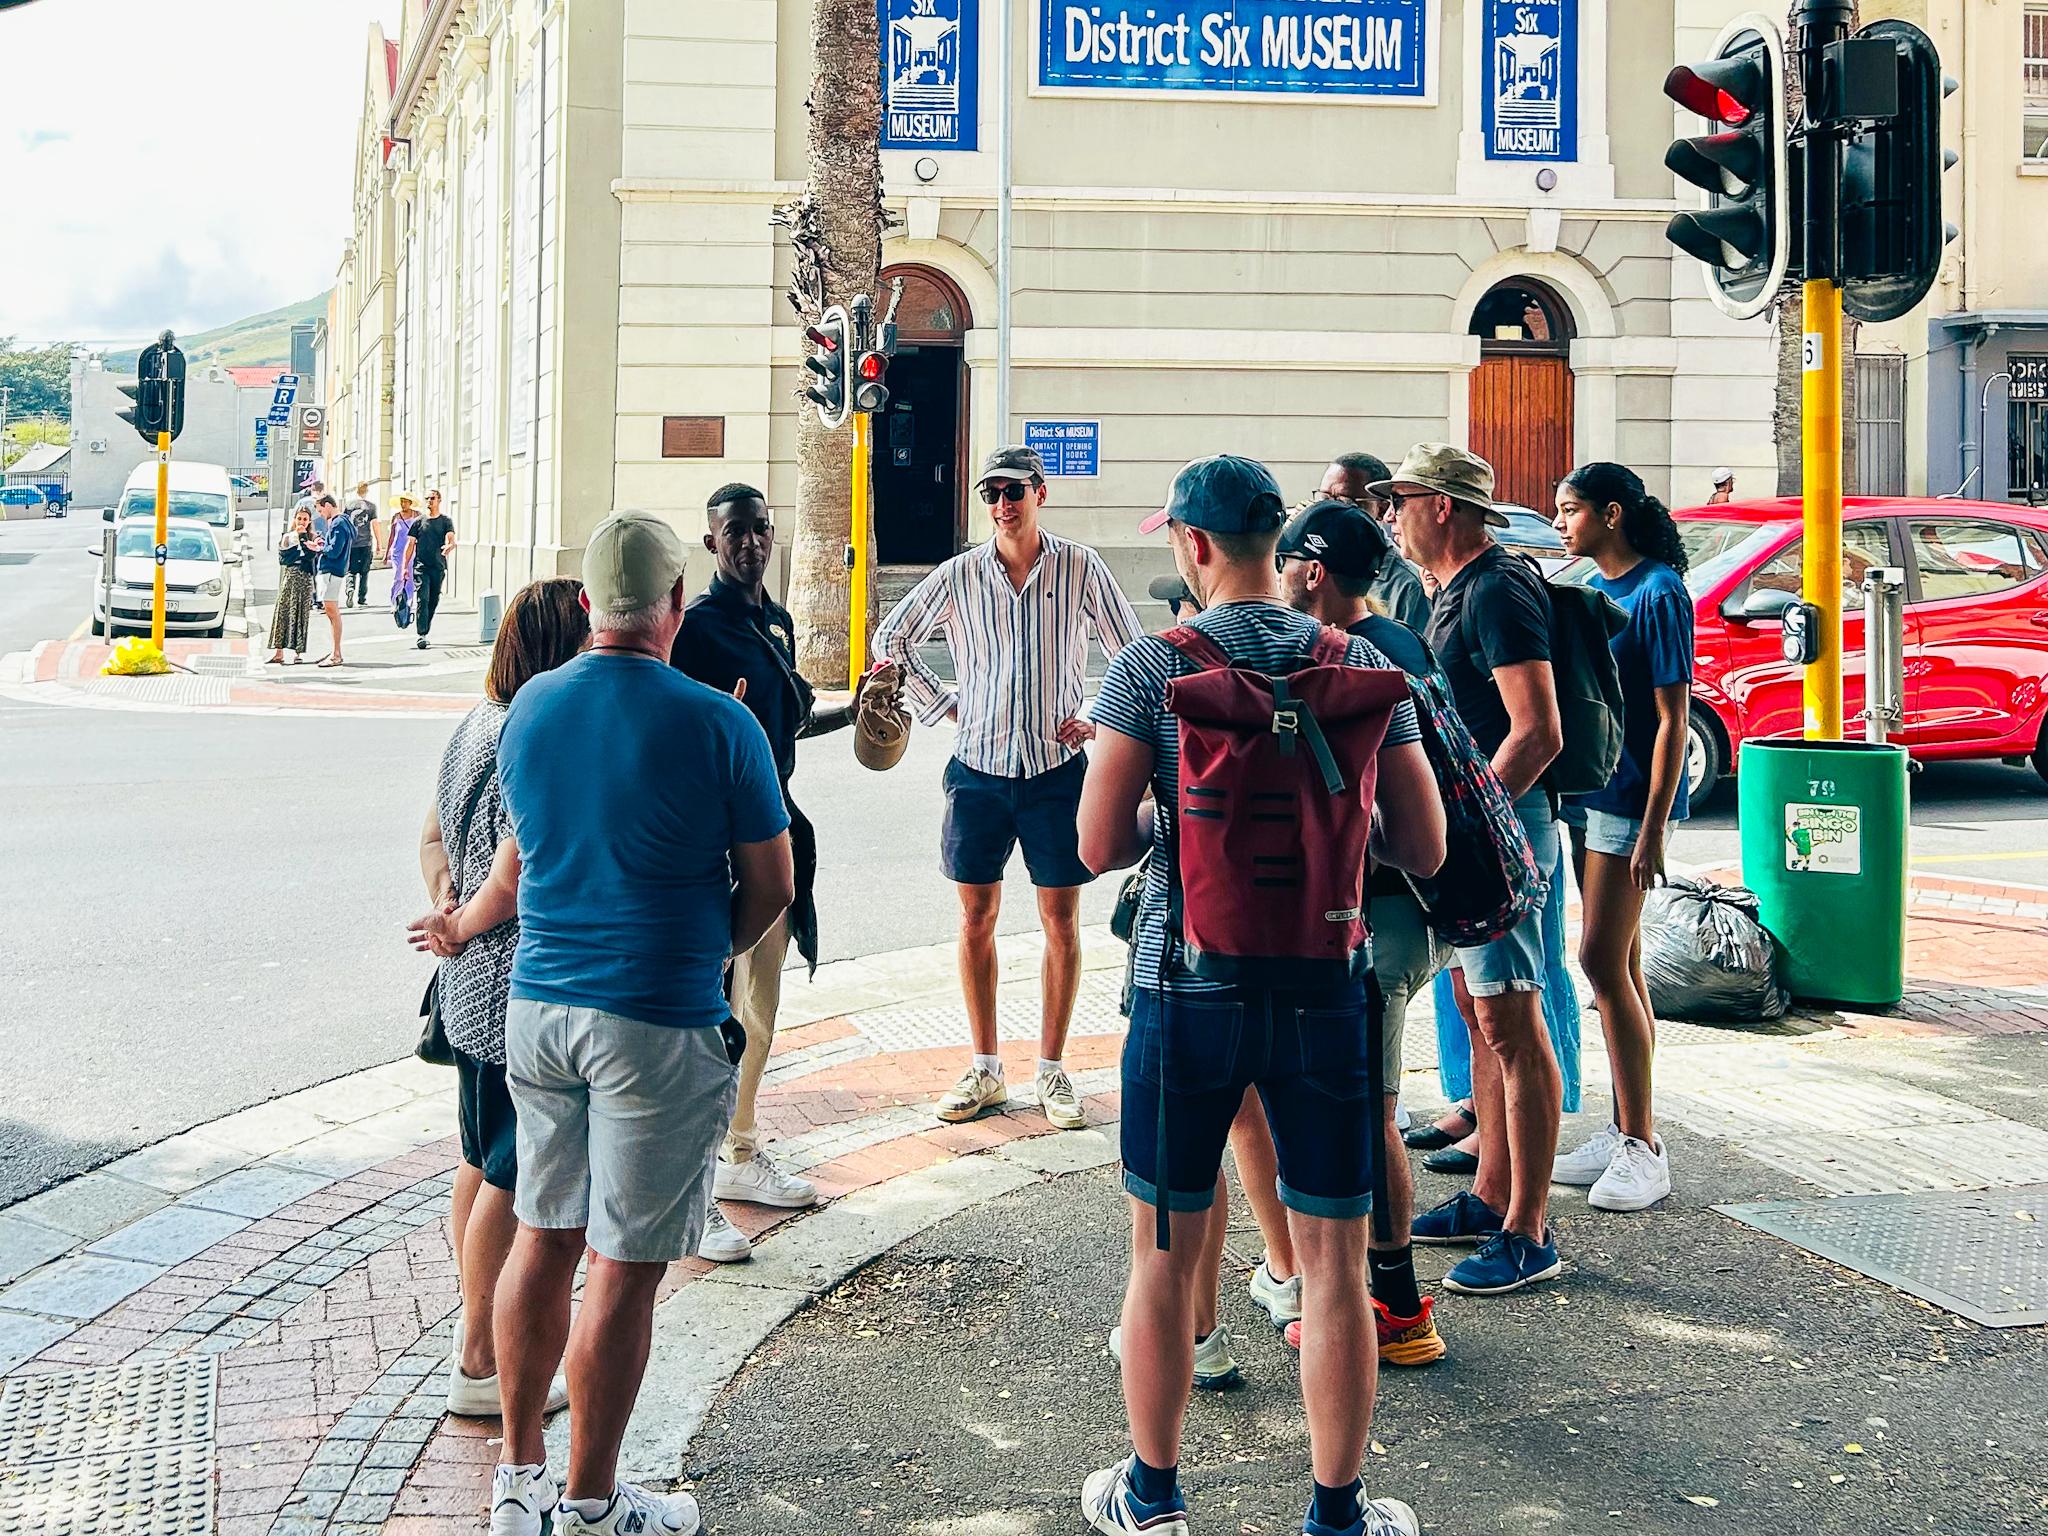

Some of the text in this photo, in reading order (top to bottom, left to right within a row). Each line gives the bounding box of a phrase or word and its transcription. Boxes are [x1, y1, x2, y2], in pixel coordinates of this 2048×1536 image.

[1515, 7, 1539, 33] Six
[1064, 7, 1402, 71] District Six MUSEUM
[892, 114, 952, 138] MUSEUM
[1498, 128, 1554, 152] MUSEUM
[278, 390, 290, 404] R
[1029, 426, 1094, 437] District Six MUSEUM
[161, 452, 166, 461] 4
[1066, 451, 1087, 459] HOURS
[1797, 818, 1857, 833] BINGO
[1812, 829, 1842, 843] BIN
